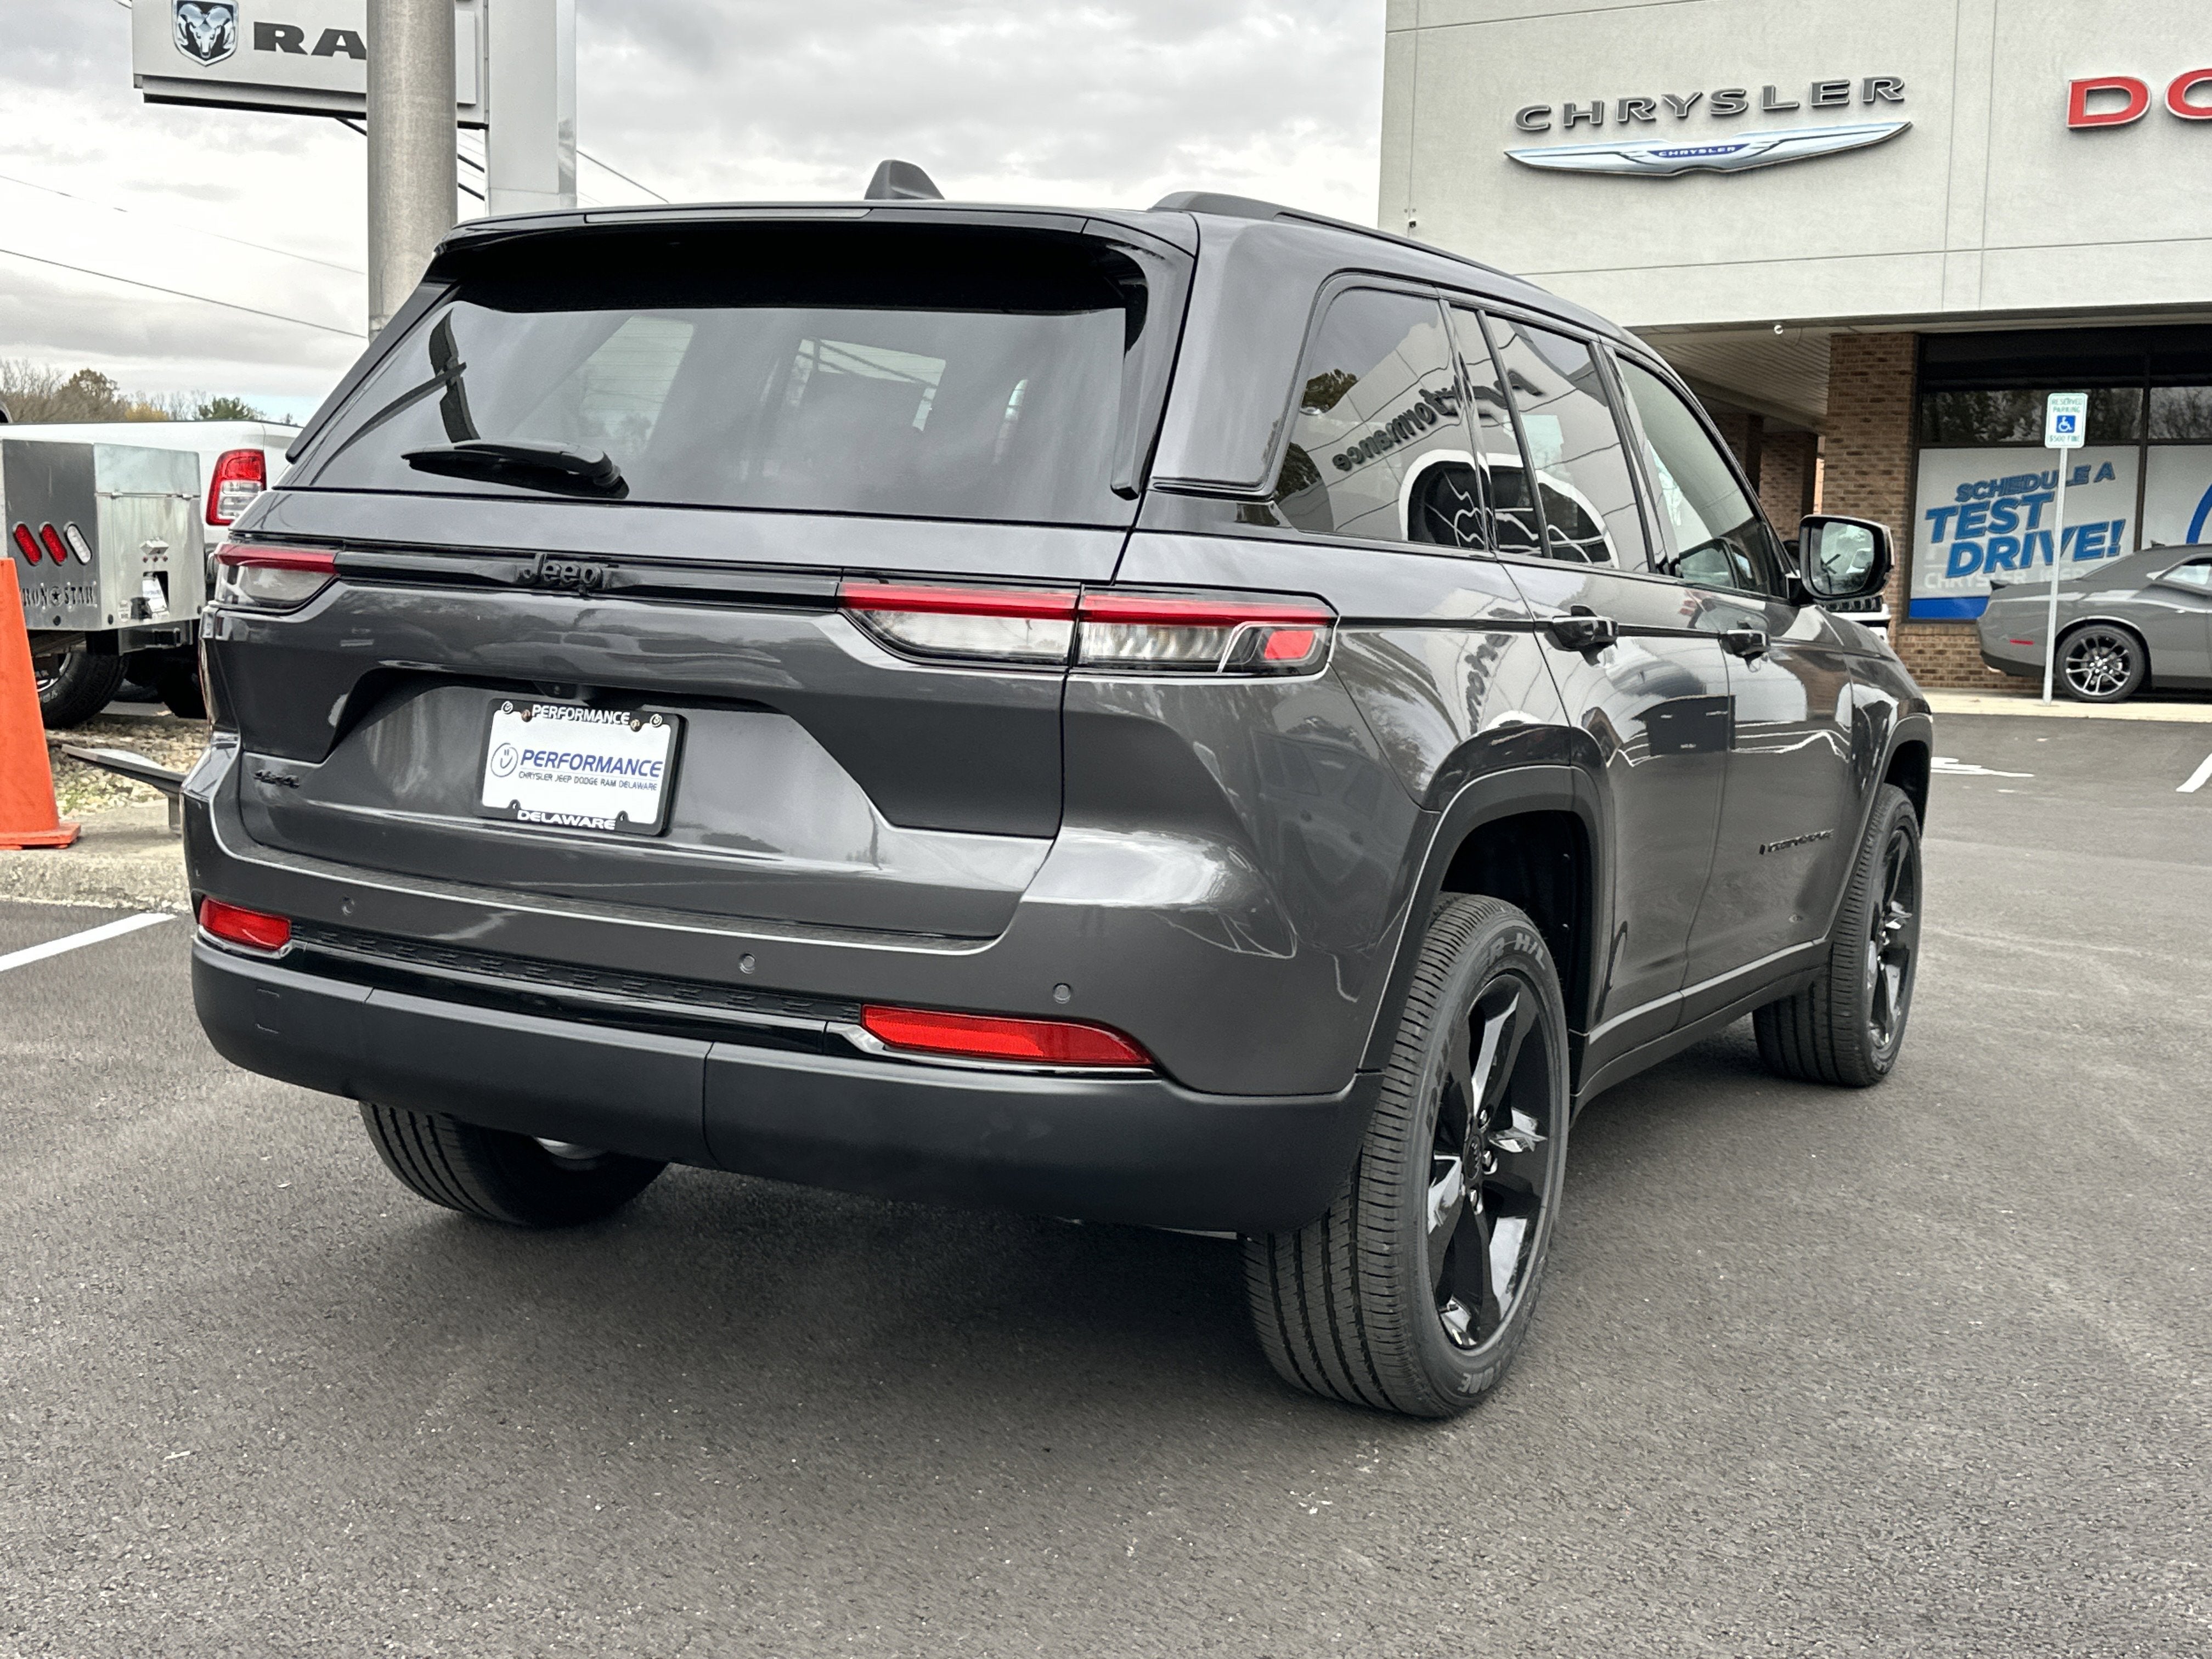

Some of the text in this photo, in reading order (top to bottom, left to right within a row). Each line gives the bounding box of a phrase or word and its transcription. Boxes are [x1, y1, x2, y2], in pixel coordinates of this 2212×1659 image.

[253, 22, 366, 59] RA
[1515, 76, 1905, 131] CHRYSLER
[1658, 146, 1736, 156] CHRYSLER
[2094, 460, 2115, 483] A
[1926, 491, 2055, 544] TEST
[1945, 519, 2126, 578] DRIVE!
[518, 552, 603, 595] Jeep
[1925, 571, 2027, 589] CHRYSER
[531, 704, 630, 725] PERFORMANCE
[520, 749, 663, 777] PERFORMANCE
[518, 771, 657, 791] CHRYSLER JEEP DODGE RAM DELAWARE
[517, 810, 616, 830] DELAWARE
